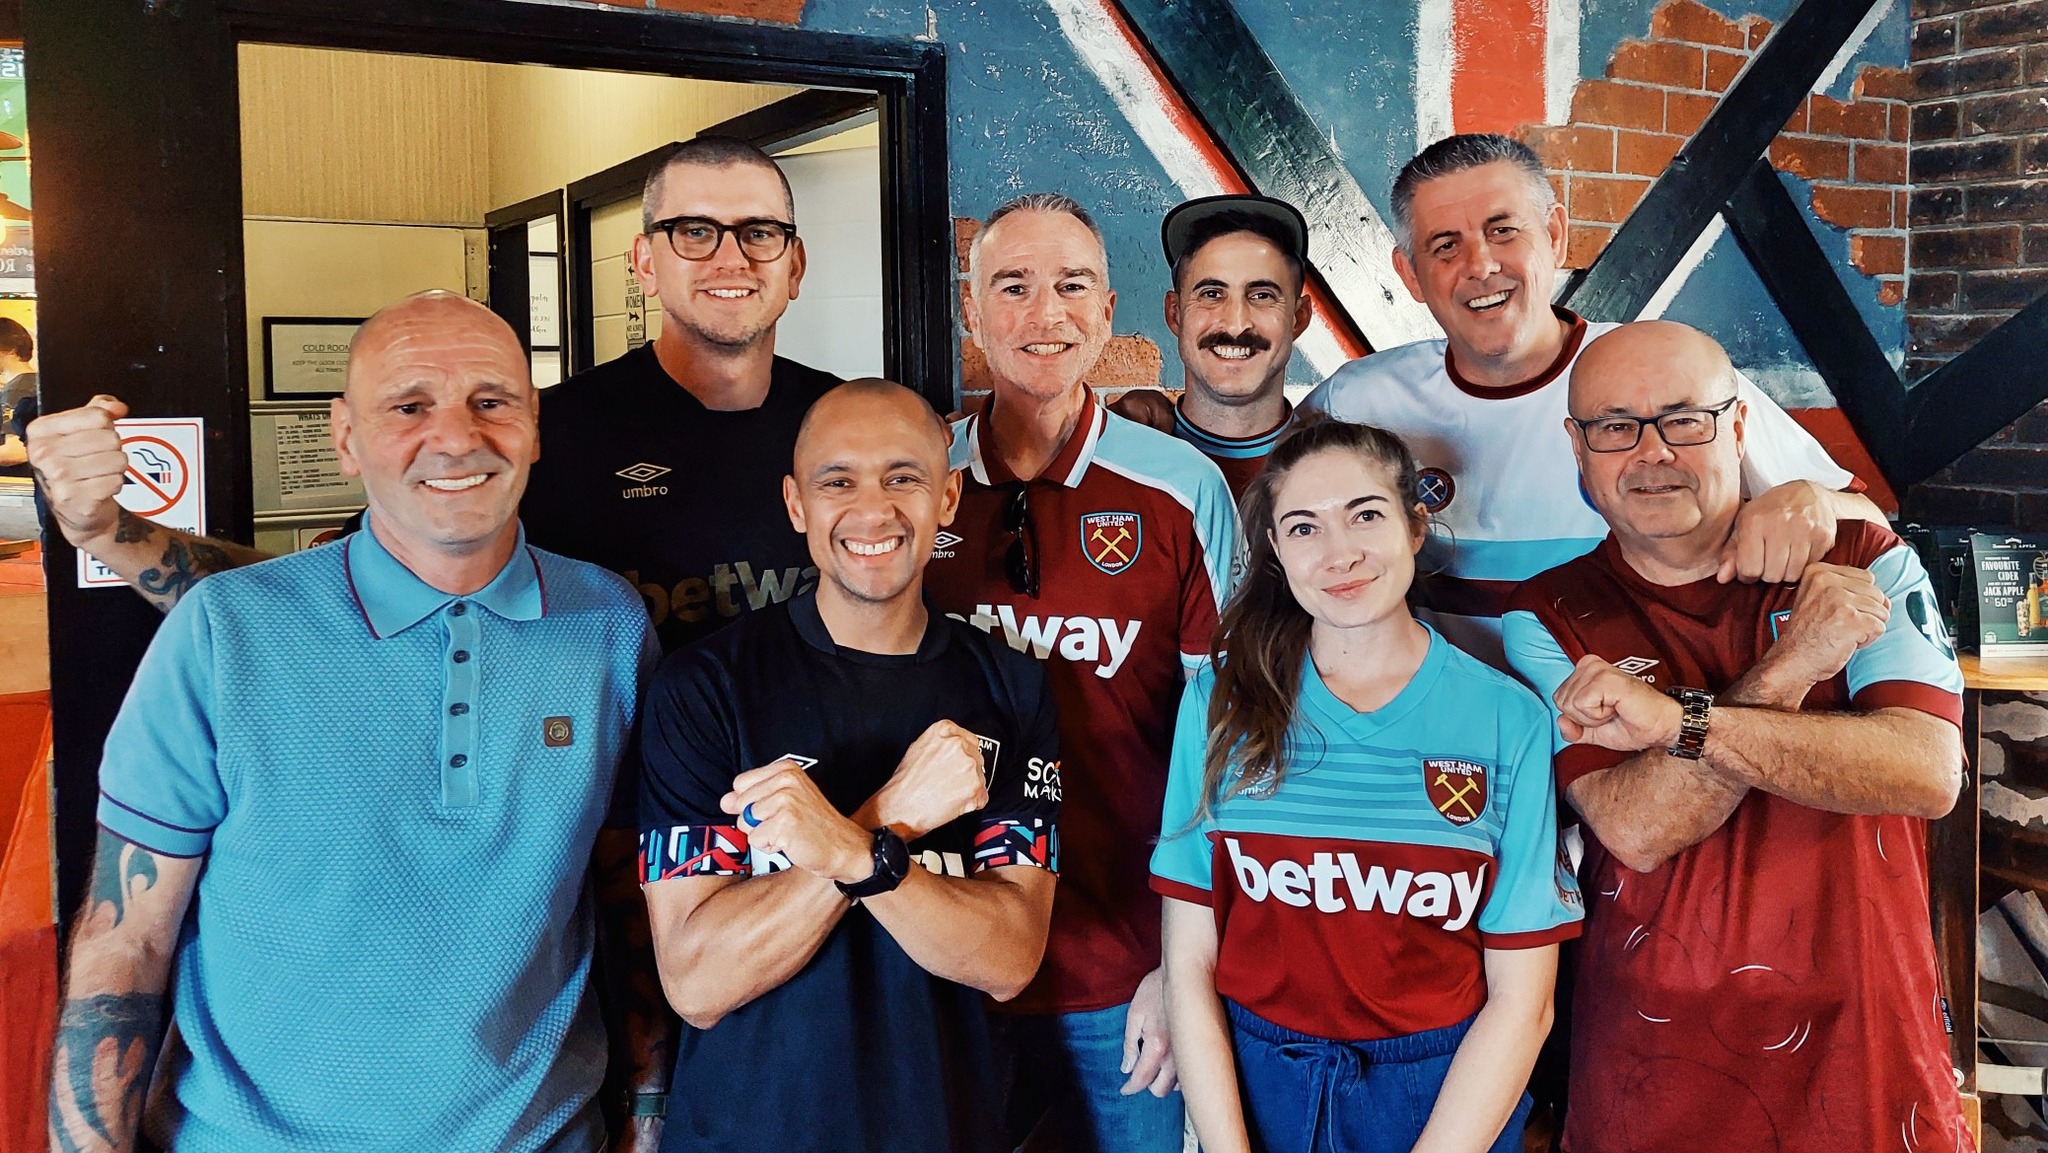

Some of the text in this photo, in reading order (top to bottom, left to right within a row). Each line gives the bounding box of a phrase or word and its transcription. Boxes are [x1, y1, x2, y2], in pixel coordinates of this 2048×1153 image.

[622, 485, 668, 499] umbro
[1087, 515, 1110, 524] WEST
[931, 549, 955, 559] mbro
[1981, 561, 2020, 570] FAVOURITE
[1998, 572, 2019, 580] CIDER
[1984, 587, 2024, 596] JACK APPLE
[945, 604, 1142, 679] tway
[978, 739, 993, 751] AM
[1428, 760, 1483, 774] WEST HAM
[1440, 766, 1472, 776] UNITED
[1446, 812, 1471, 822] LONDON
[1224, 838, 1489, 931] betway
